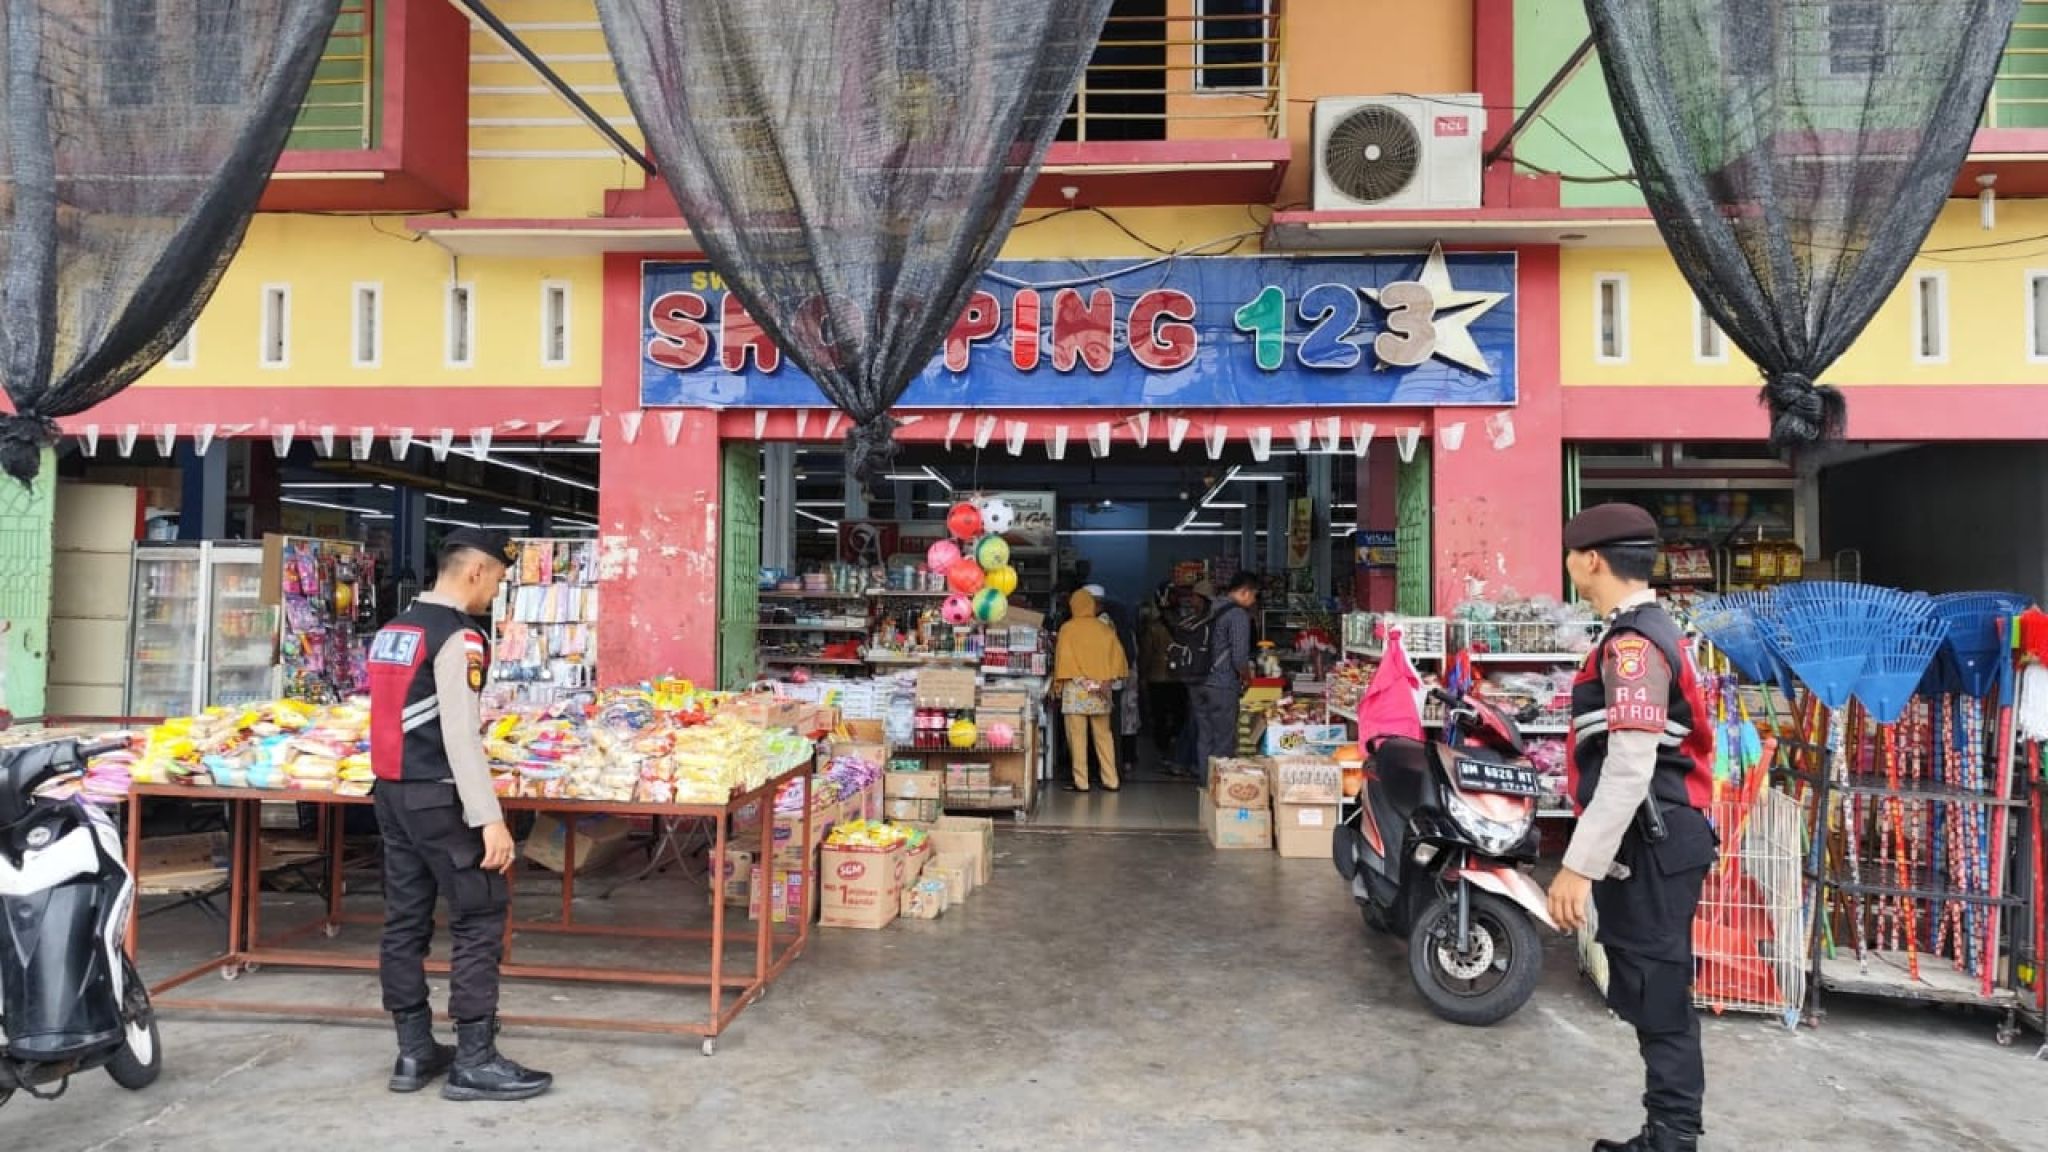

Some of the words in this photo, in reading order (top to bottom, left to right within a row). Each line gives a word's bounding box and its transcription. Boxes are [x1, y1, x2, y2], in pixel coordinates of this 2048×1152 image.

[1438, 122, 1464, 131] TCL
[648, 288, 1198, 374] SHOPING
[1234, 281, 1438, 371] 123
